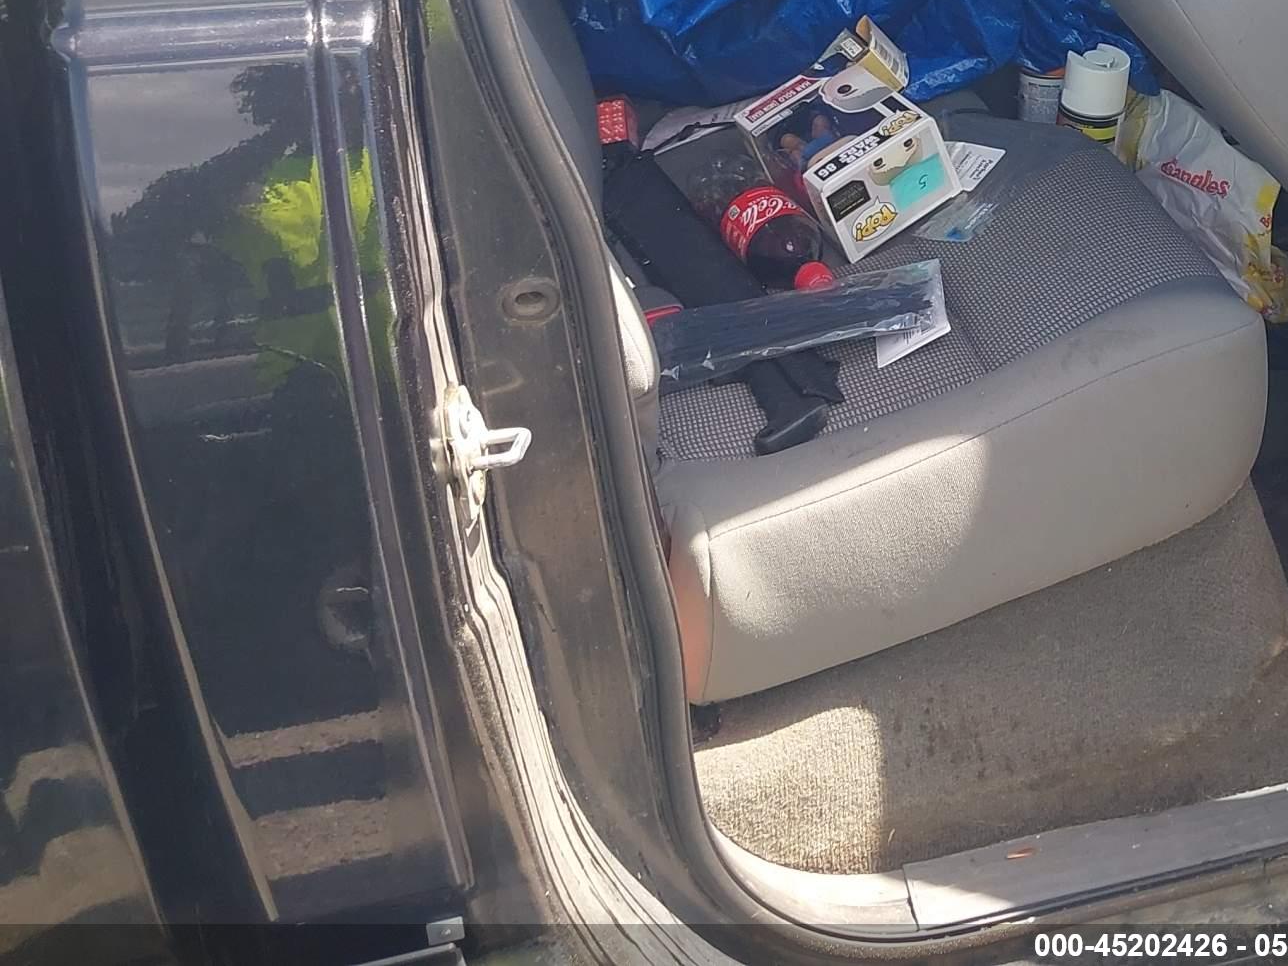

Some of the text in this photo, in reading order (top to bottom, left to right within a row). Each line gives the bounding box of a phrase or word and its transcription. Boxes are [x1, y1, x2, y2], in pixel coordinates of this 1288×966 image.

[881, 111, 921, 136] POP!
[838, 133, 881, 163] WARS
[844, 139, 880, 164] STAR
[817, 162, 838, 178] 86
[855, 204, 898, 242] POP!
